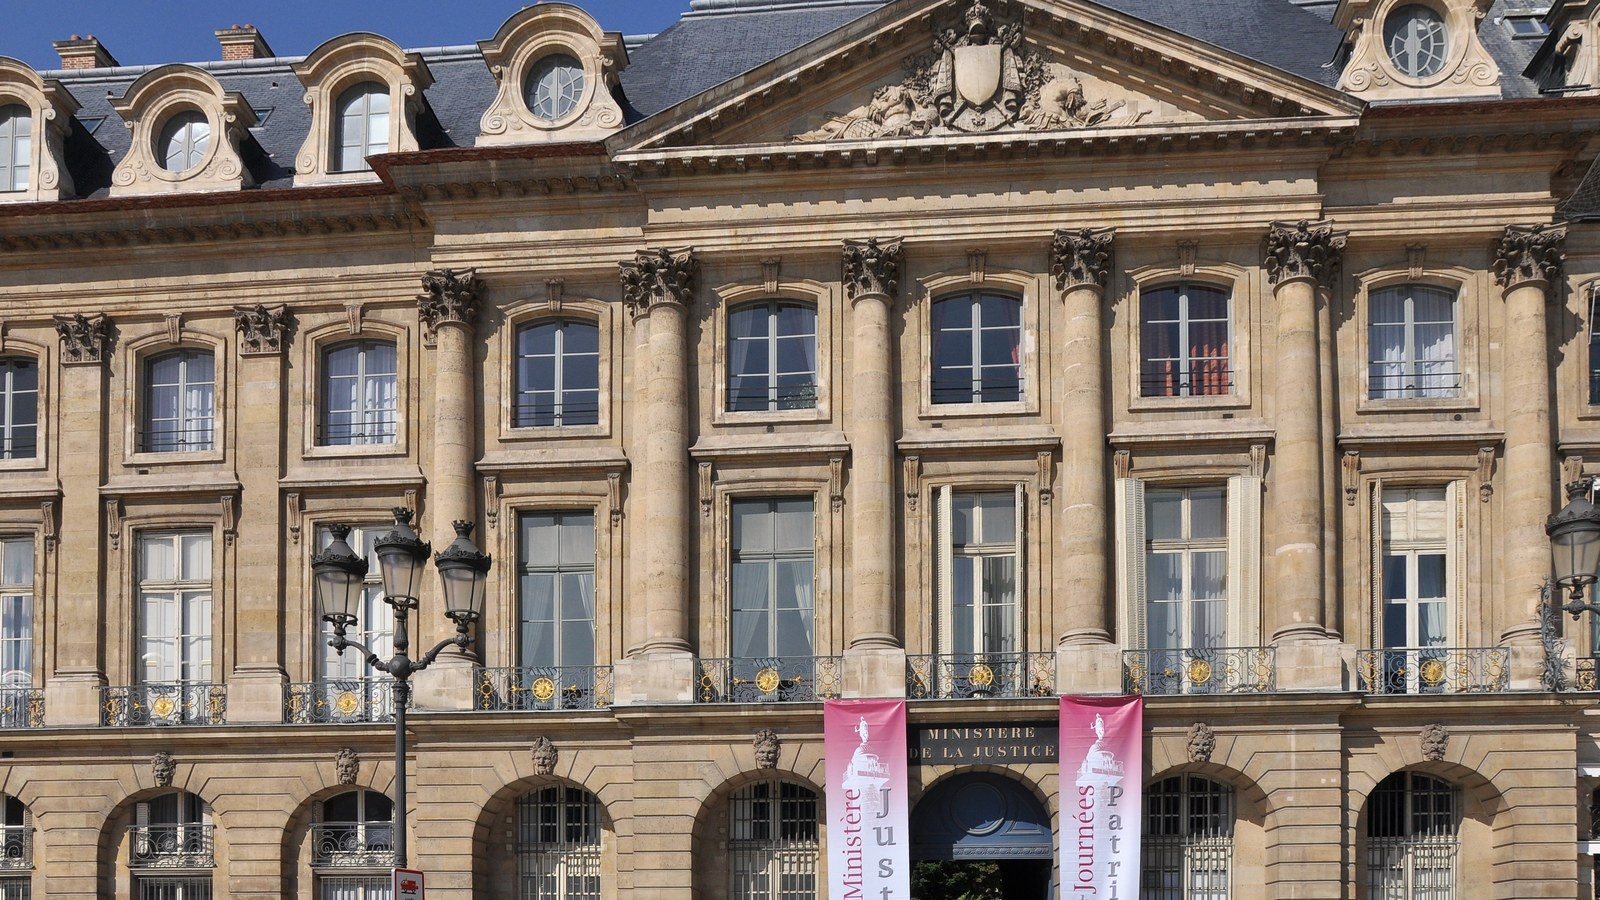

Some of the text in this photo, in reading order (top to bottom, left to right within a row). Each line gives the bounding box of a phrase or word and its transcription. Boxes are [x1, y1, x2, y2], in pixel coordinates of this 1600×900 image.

[928, 727, 1035, 740] MINISTERE
[909, 745, 1055, 759] DE LA JUSTICE
[1072, 785, 1097, 895] Journées
